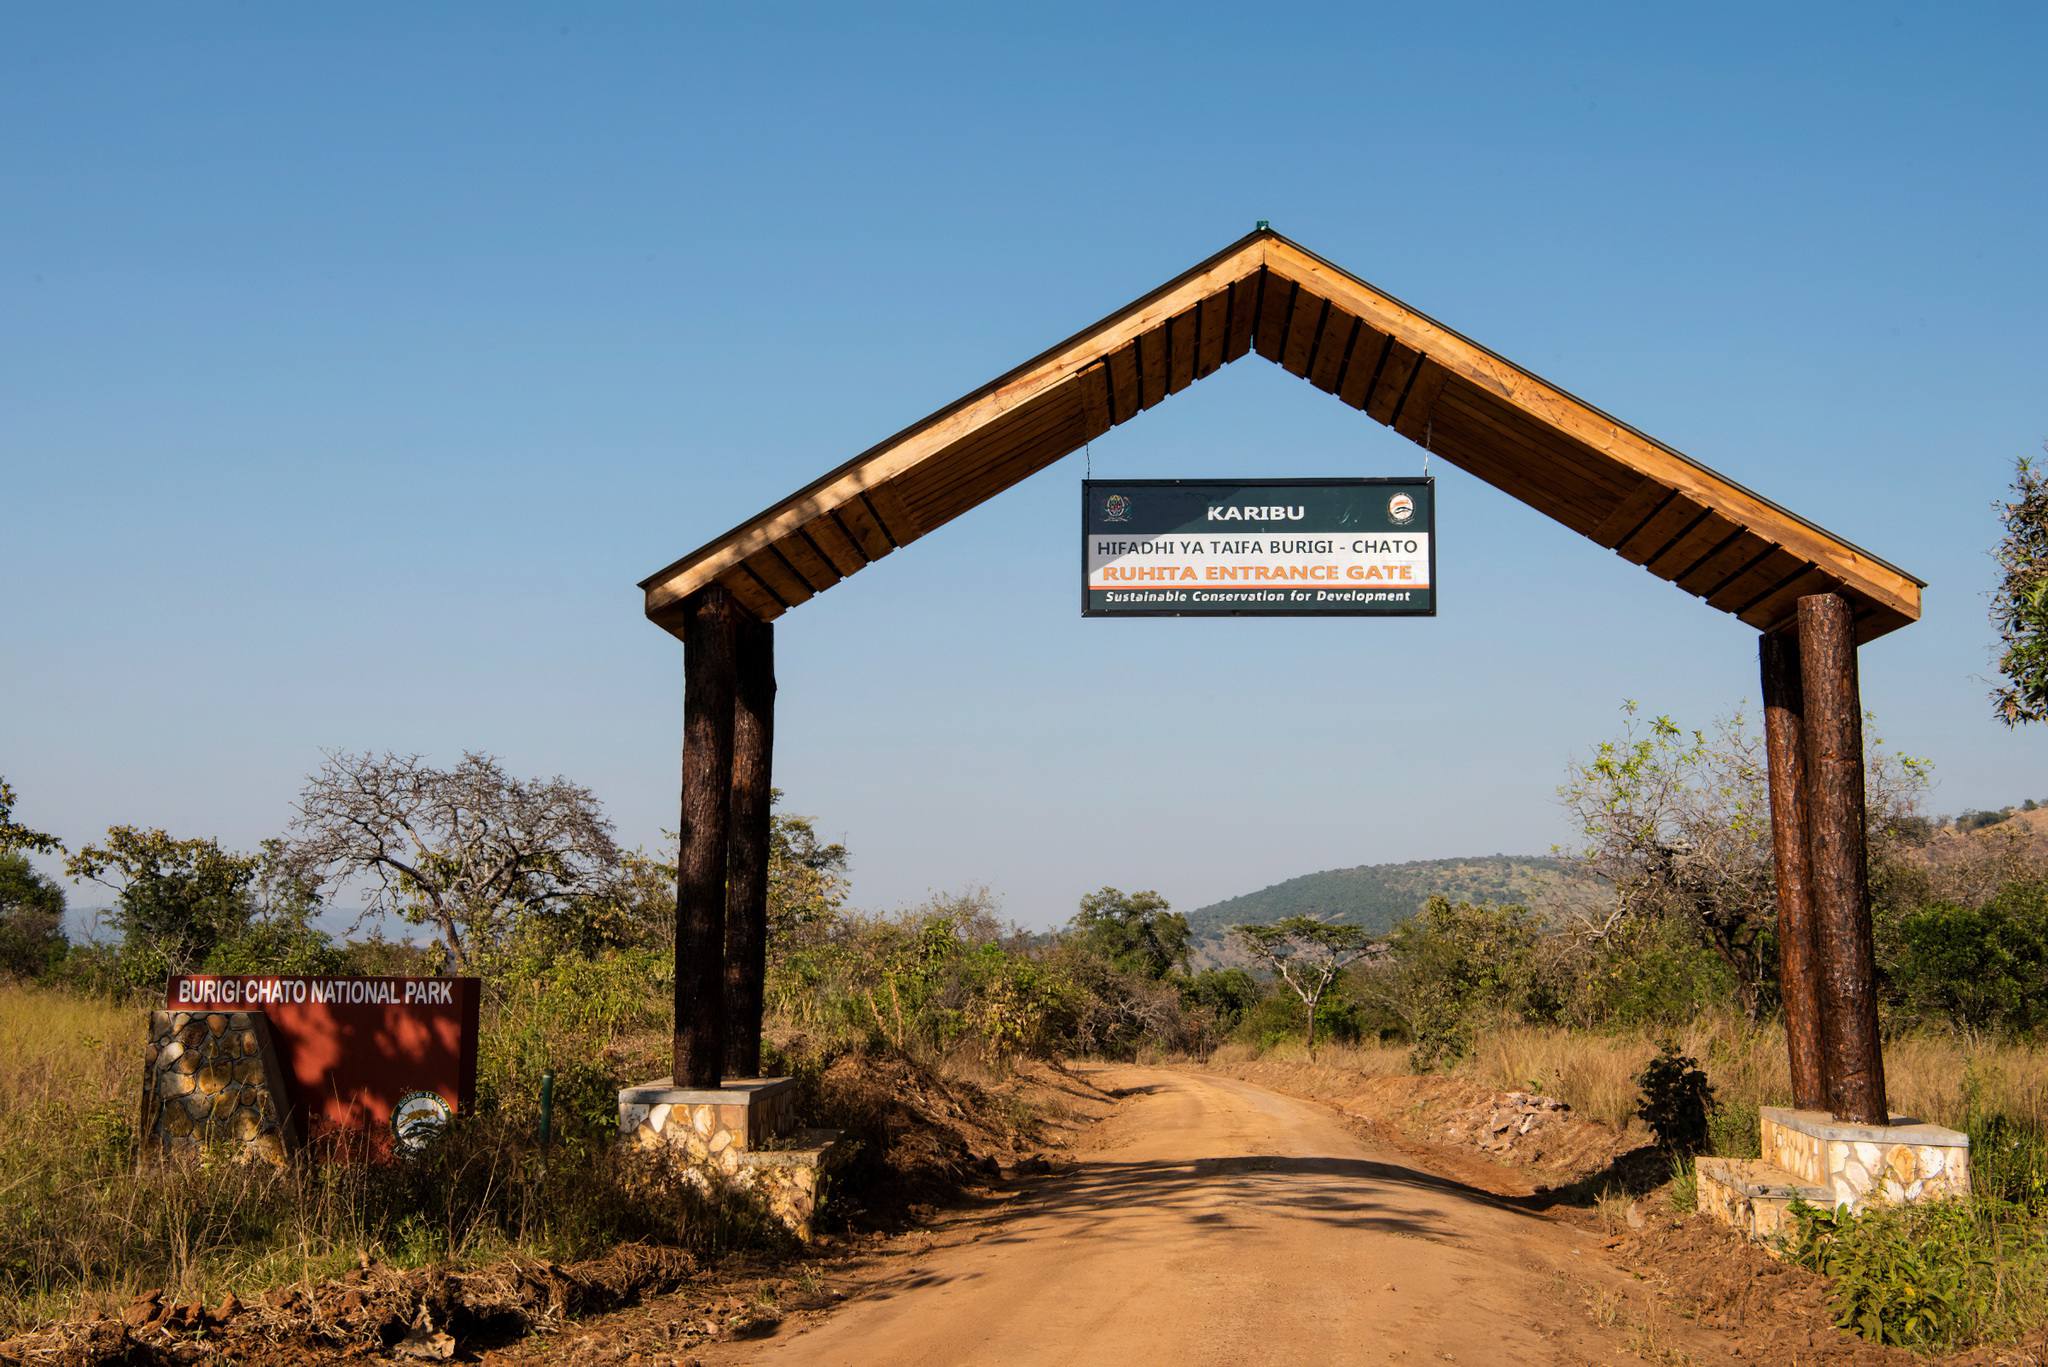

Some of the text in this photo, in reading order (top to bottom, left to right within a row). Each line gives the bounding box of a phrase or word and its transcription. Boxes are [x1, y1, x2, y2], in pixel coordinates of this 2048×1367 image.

[1208, 506, 1304, 520] KARIBU
[1098, 541, 1174, 555] HIFADHI
[1180, 541, 1204, 555] YA
[1210, 541, 1263, 555] TAIFA
[1270, 540, 1334, 554] BURIGI
[1352, 539, 1418, 554] CHATO
[1103, 565, 1413, 580] RUHITA ENTRANCE GATE
[1106, 590, 1411, 604] Sustainable Conservation for Development
[179, 980, 452, 1004] BURIGI-CHATO NATIONAL PARK
